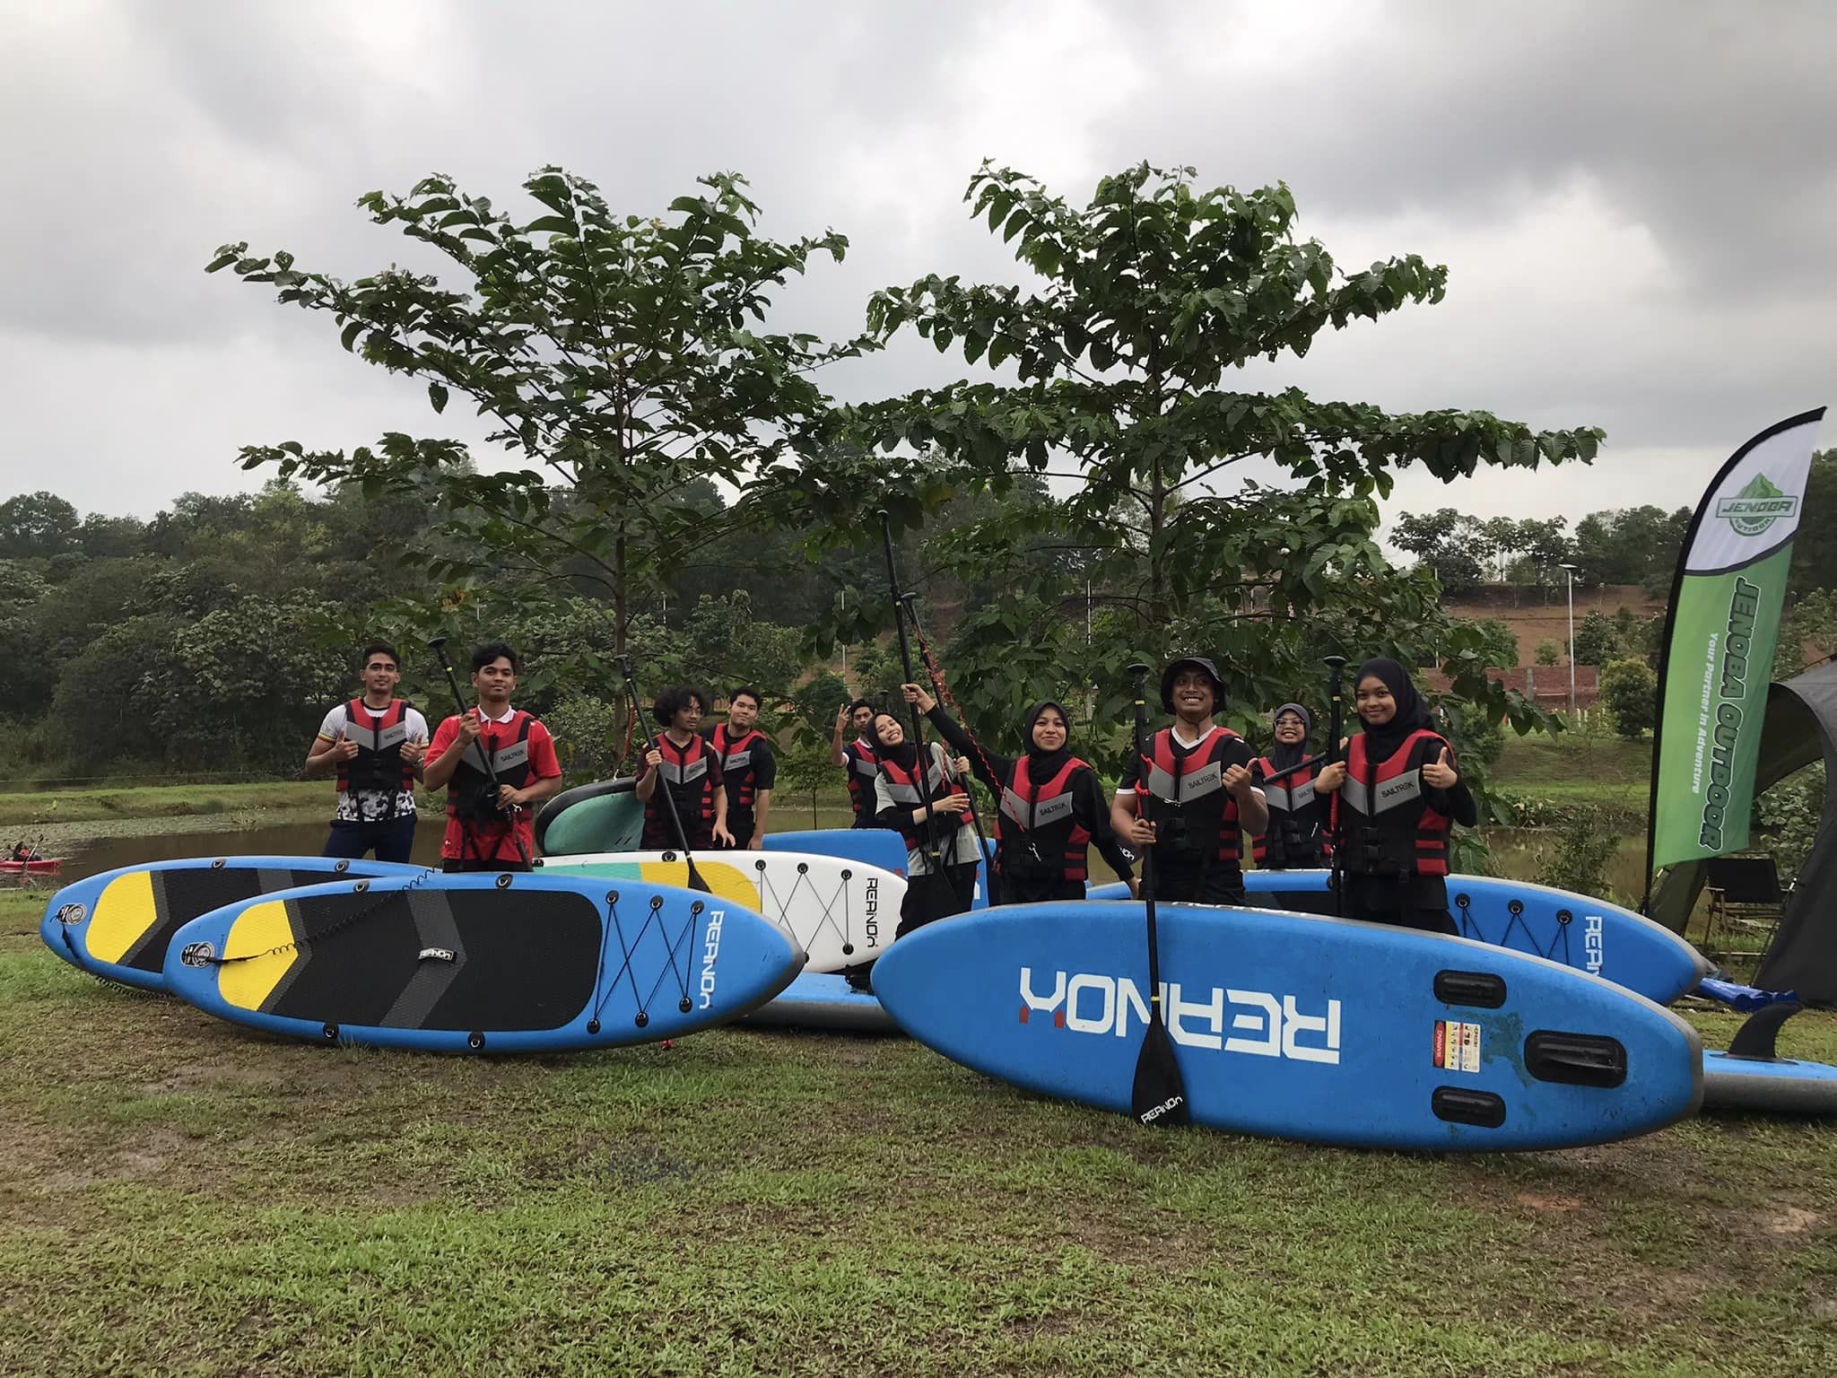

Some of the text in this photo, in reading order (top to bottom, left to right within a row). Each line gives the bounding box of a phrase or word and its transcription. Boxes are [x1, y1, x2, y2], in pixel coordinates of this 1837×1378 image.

[1722, 500, 1794, 513] JENOBA
[1707, 632, 1719, 660] Your
[1701, 662, 1715, 712] Partner
[1698, 575, 1761, 851] JENOBA OUTDOOR
[1692, 727, 1707, 795] Adventure
